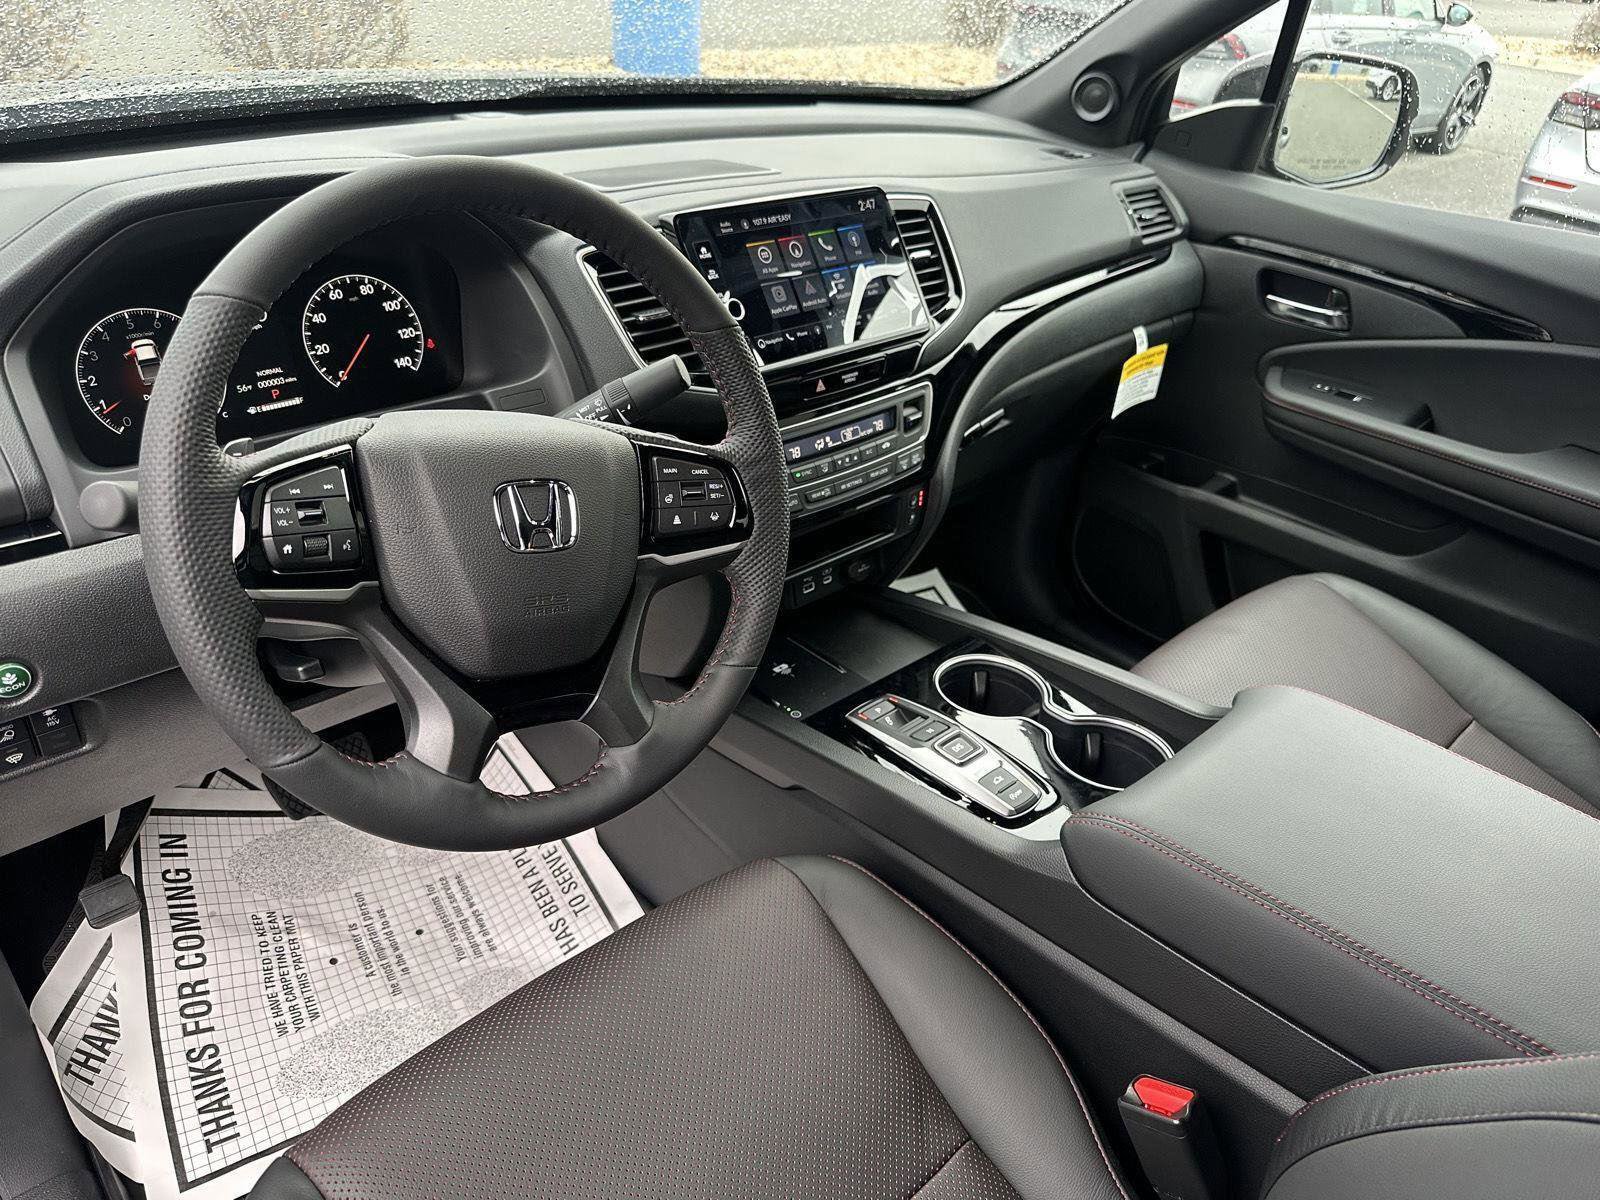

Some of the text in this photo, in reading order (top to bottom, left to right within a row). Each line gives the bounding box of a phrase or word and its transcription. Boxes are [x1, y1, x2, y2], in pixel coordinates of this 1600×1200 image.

[858, 198, 876, 212] 2:47
[329, 288, 343, 300] 60
[359, 283, 374, 295] 80
[382, 300, 401, 312] 100
[782, 304, 798, 312] CarPlay
[153, 318, 162, 329] 6
[312, 312, 327, 324] 40
[126, 319, 135, 330] 5
[101, 331, 110, 342] 4
[397, 327, 416, 339] 120
[314, 343, 330, 355] 20
[89, 350, 99, 362] 3
[394, 356, 412, 368] 140
[256, 367, 283, 377] NORMAL
[87, 375, 98, 387] 2
[257, 377, 285, 389] 000003
[271, 389, 280, 399] P
[122, 416, 132, 427] 0
[788, 446, 801, 459] 78
[872, 419, 884, 431] 78
[0, 681, 26, 694] ECON
[47, 714, 58, 722] AC
[541, 845, 590, 918] TO SERVE
[509, 848, 580, 955] HAS BEEN A PL
[439, 875, 484, 959] improving our service
[455, 871, 498, 952] are always welcome.
[381, 920, 391, 930] to
[426, 883, 468, 963] Your suggestions for
[354, 891, 402, 997] the most important person
[383, 930, 400, 952] world
[348, 922, 377, 978] A customer is
[395, 953, 407, 966] the
[266, 911, 306, 1033] YOUR CARPETING CLEAN
[282, 914, 321, 1022] WITH THIS PAPER MAT
[401, 966, 411, 976] in
[252, 913, 289, 1037] WE HAVE TRIED TO KEEP
[158, 834, 240, 1154] THANKS FOR COMING IN
[64, 980, 121, 1087] THANK
